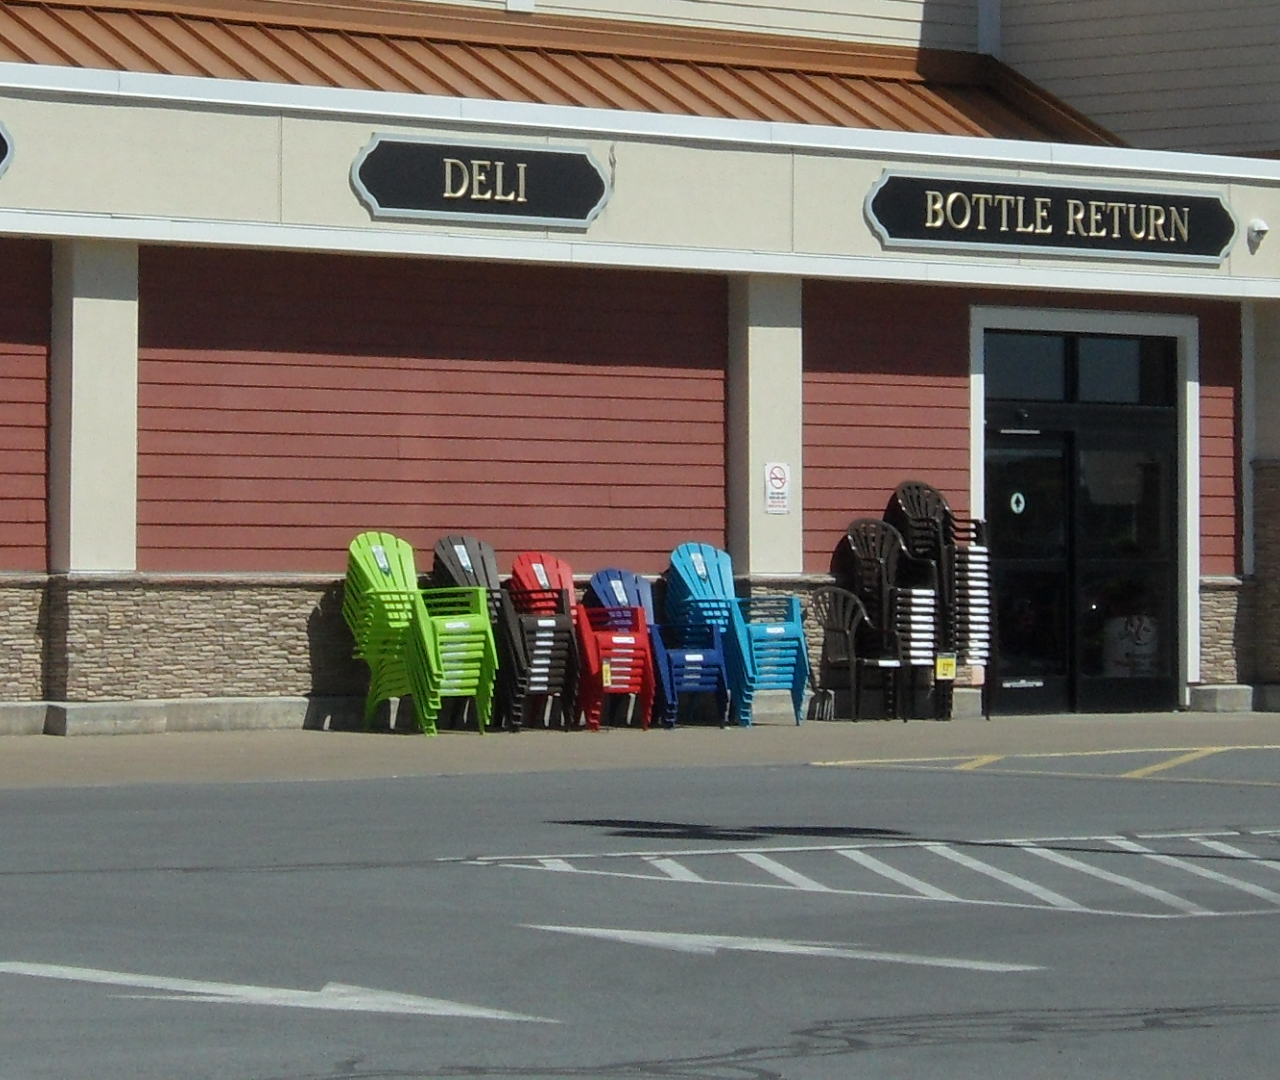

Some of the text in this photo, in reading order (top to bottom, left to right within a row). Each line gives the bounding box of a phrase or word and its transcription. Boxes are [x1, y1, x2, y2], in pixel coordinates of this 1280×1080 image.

[442, 157, 528, 203] DELI
[924, 189, 1191, 243] BOTTLE RETURN
